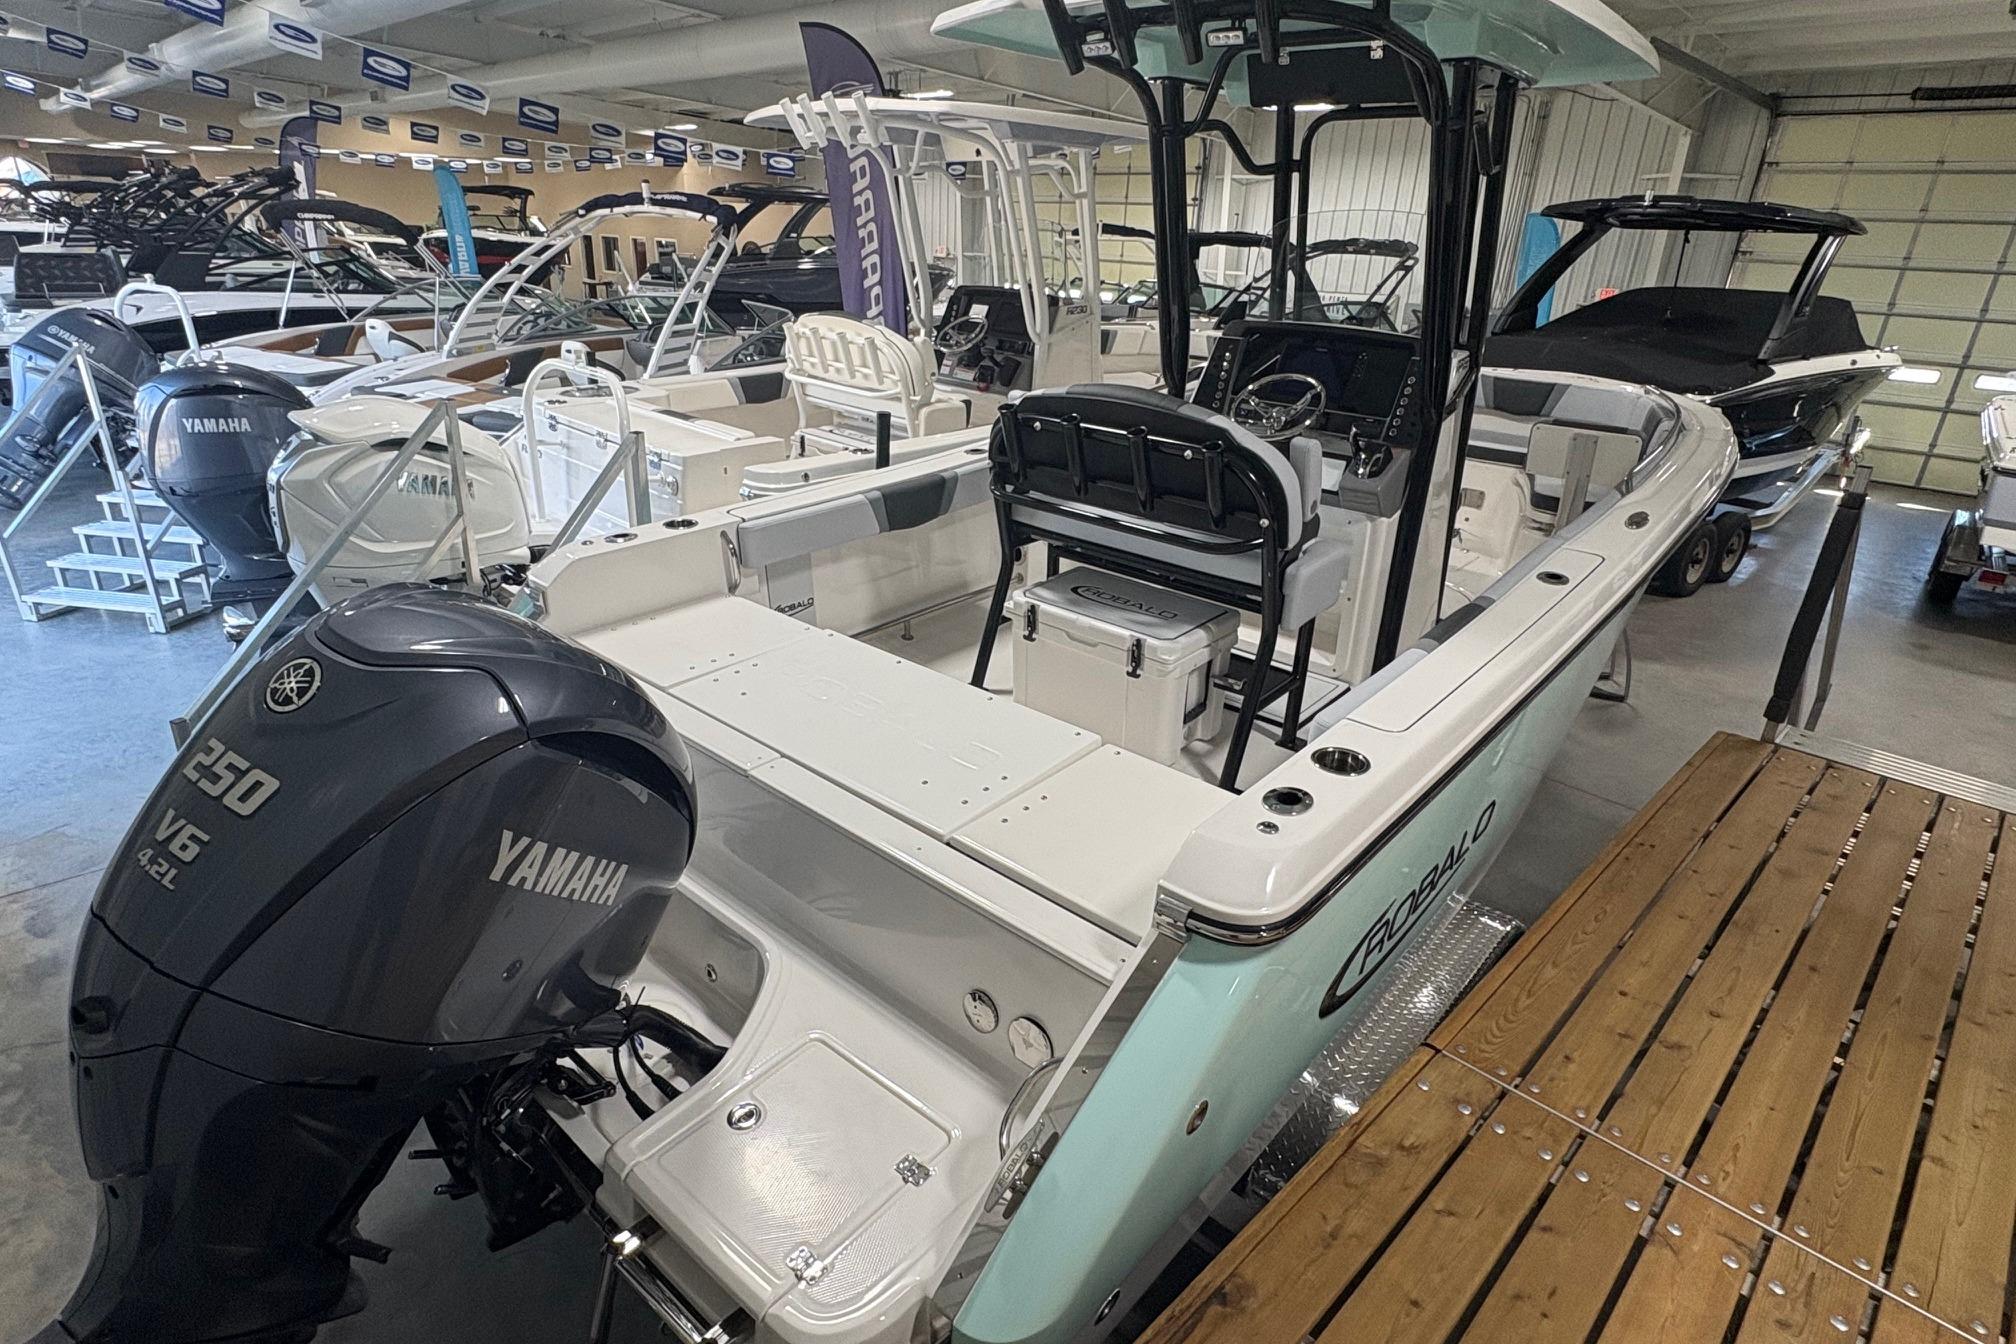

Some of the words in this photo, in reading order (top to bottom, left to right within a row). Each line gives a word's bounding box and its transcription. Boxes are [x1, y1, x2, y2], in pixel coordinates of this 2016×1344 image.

[182, 418, 252, 433] YAMAHA
[398, 472, 476, 499] YAMAA
[1080, 587, 1178, 619] ROBALO
[183, 738, 280, 816] 250
[154, 808, 210, 862] V6
[137, 849, 179, 891] 4.2L
[489, 829, 629, 906] YAMAHA
[1354, 800, 1496, 980] ROBALO
